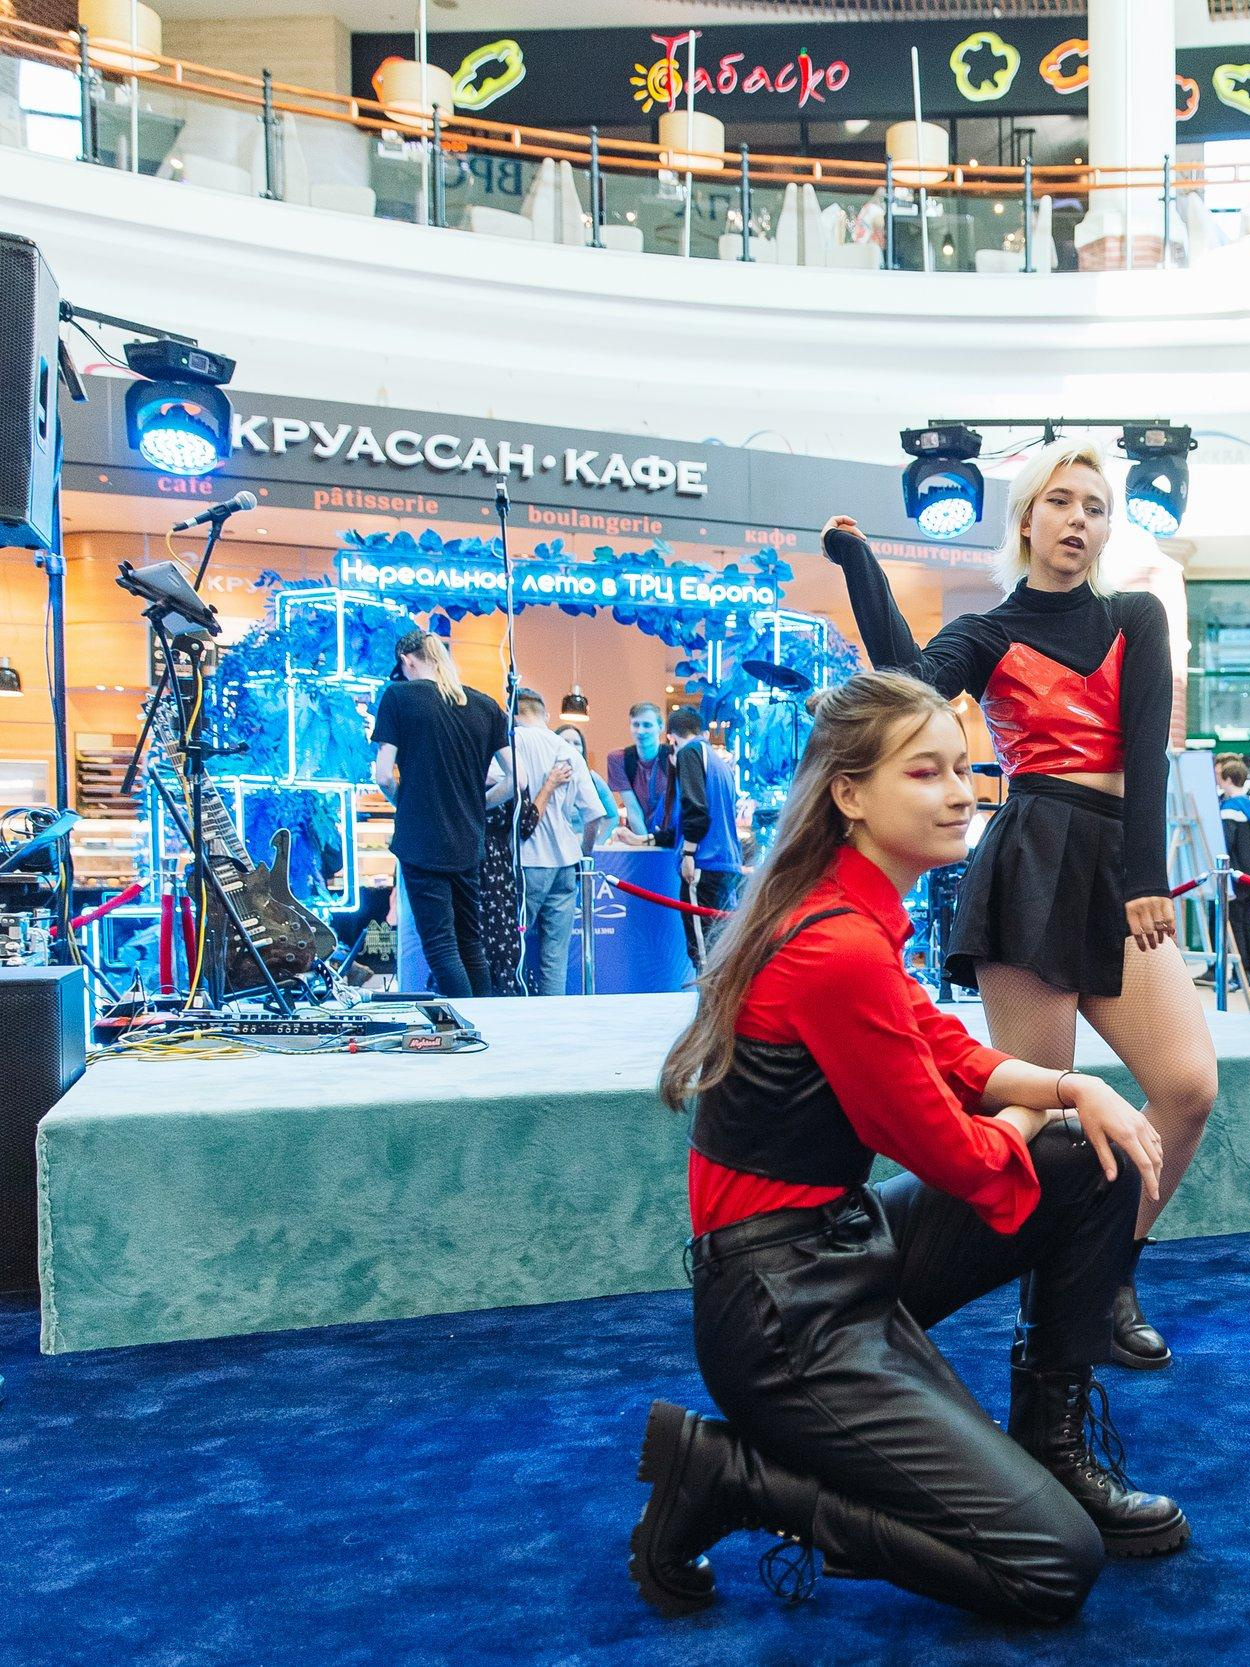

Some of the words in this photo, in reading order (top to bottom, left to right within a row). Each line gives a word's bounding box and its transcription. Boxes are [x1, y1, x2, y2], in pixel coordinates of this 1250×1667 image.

[651, 30, 850, 113] Табаско
[232, 413, 534, 478] КРУАССАН
[564, 448, 709, 496] КАФЕ
[157, 476, 214, 495] café
[313, 487, 439, 514] pâtisserie
[527, 505, 664, 535] boulangerie
[744, 528, 798, 549] кафе
[870, 541, 993, 566] кондитерска
[341, 558, 515, 590] Нереальное
[522, 574, 596, 595] лето
[602, 578, 617, 597] в
[623, 573, 674, 602] ТРЦ
[680, 577, 774, 607] Европа
